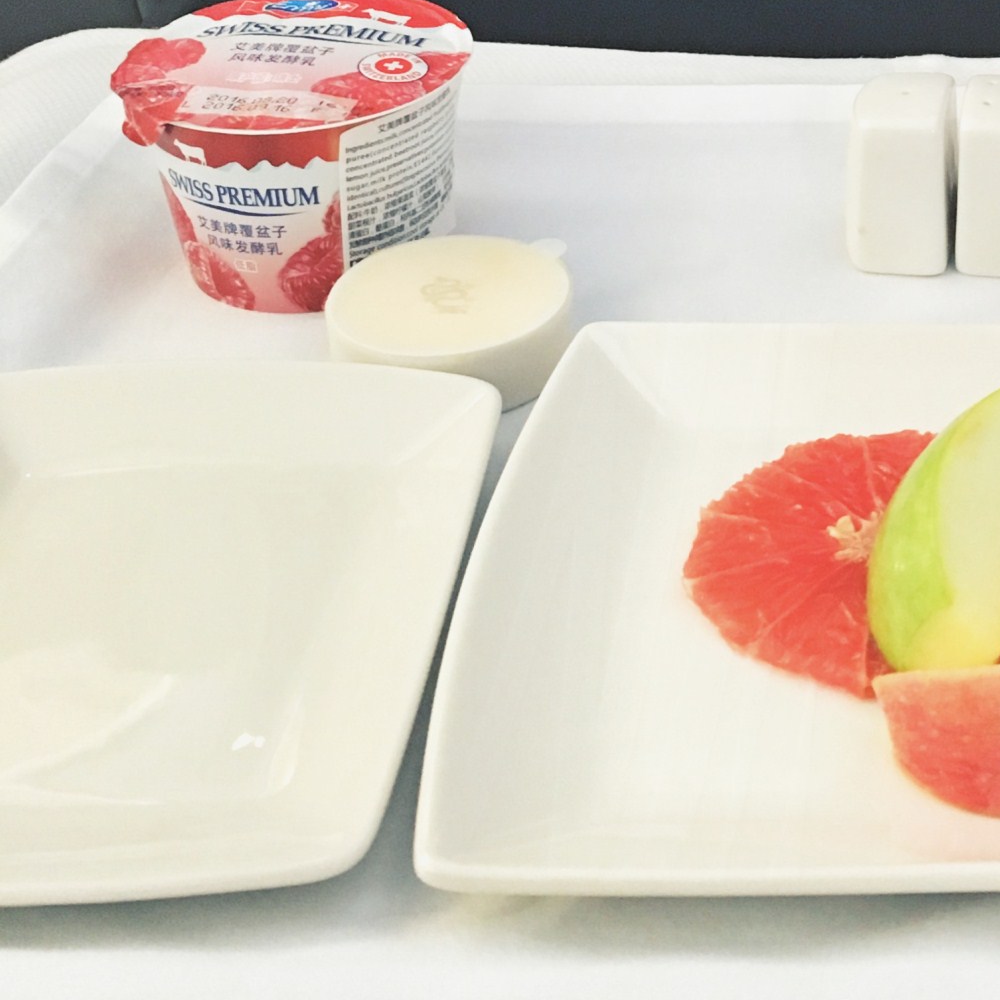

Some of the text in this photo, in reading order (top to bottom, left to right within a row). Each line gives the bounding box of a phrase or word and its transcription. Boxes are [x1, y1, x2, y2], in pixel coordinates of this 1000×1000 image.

[197, 21, 428, 48] SWISS PREMIUM
[230, 42, 335, 56] 艾美牌覆盆子
[228, 53, 316, 67] 风味发酵乳
[168, 168, 213, 201] SWISS
[215, 184, 320, 207] PREMIUM
[197, 216, 287, 238] 艾美牌覆盆子
[207, 234, 283, 255] 风味发酵乳
